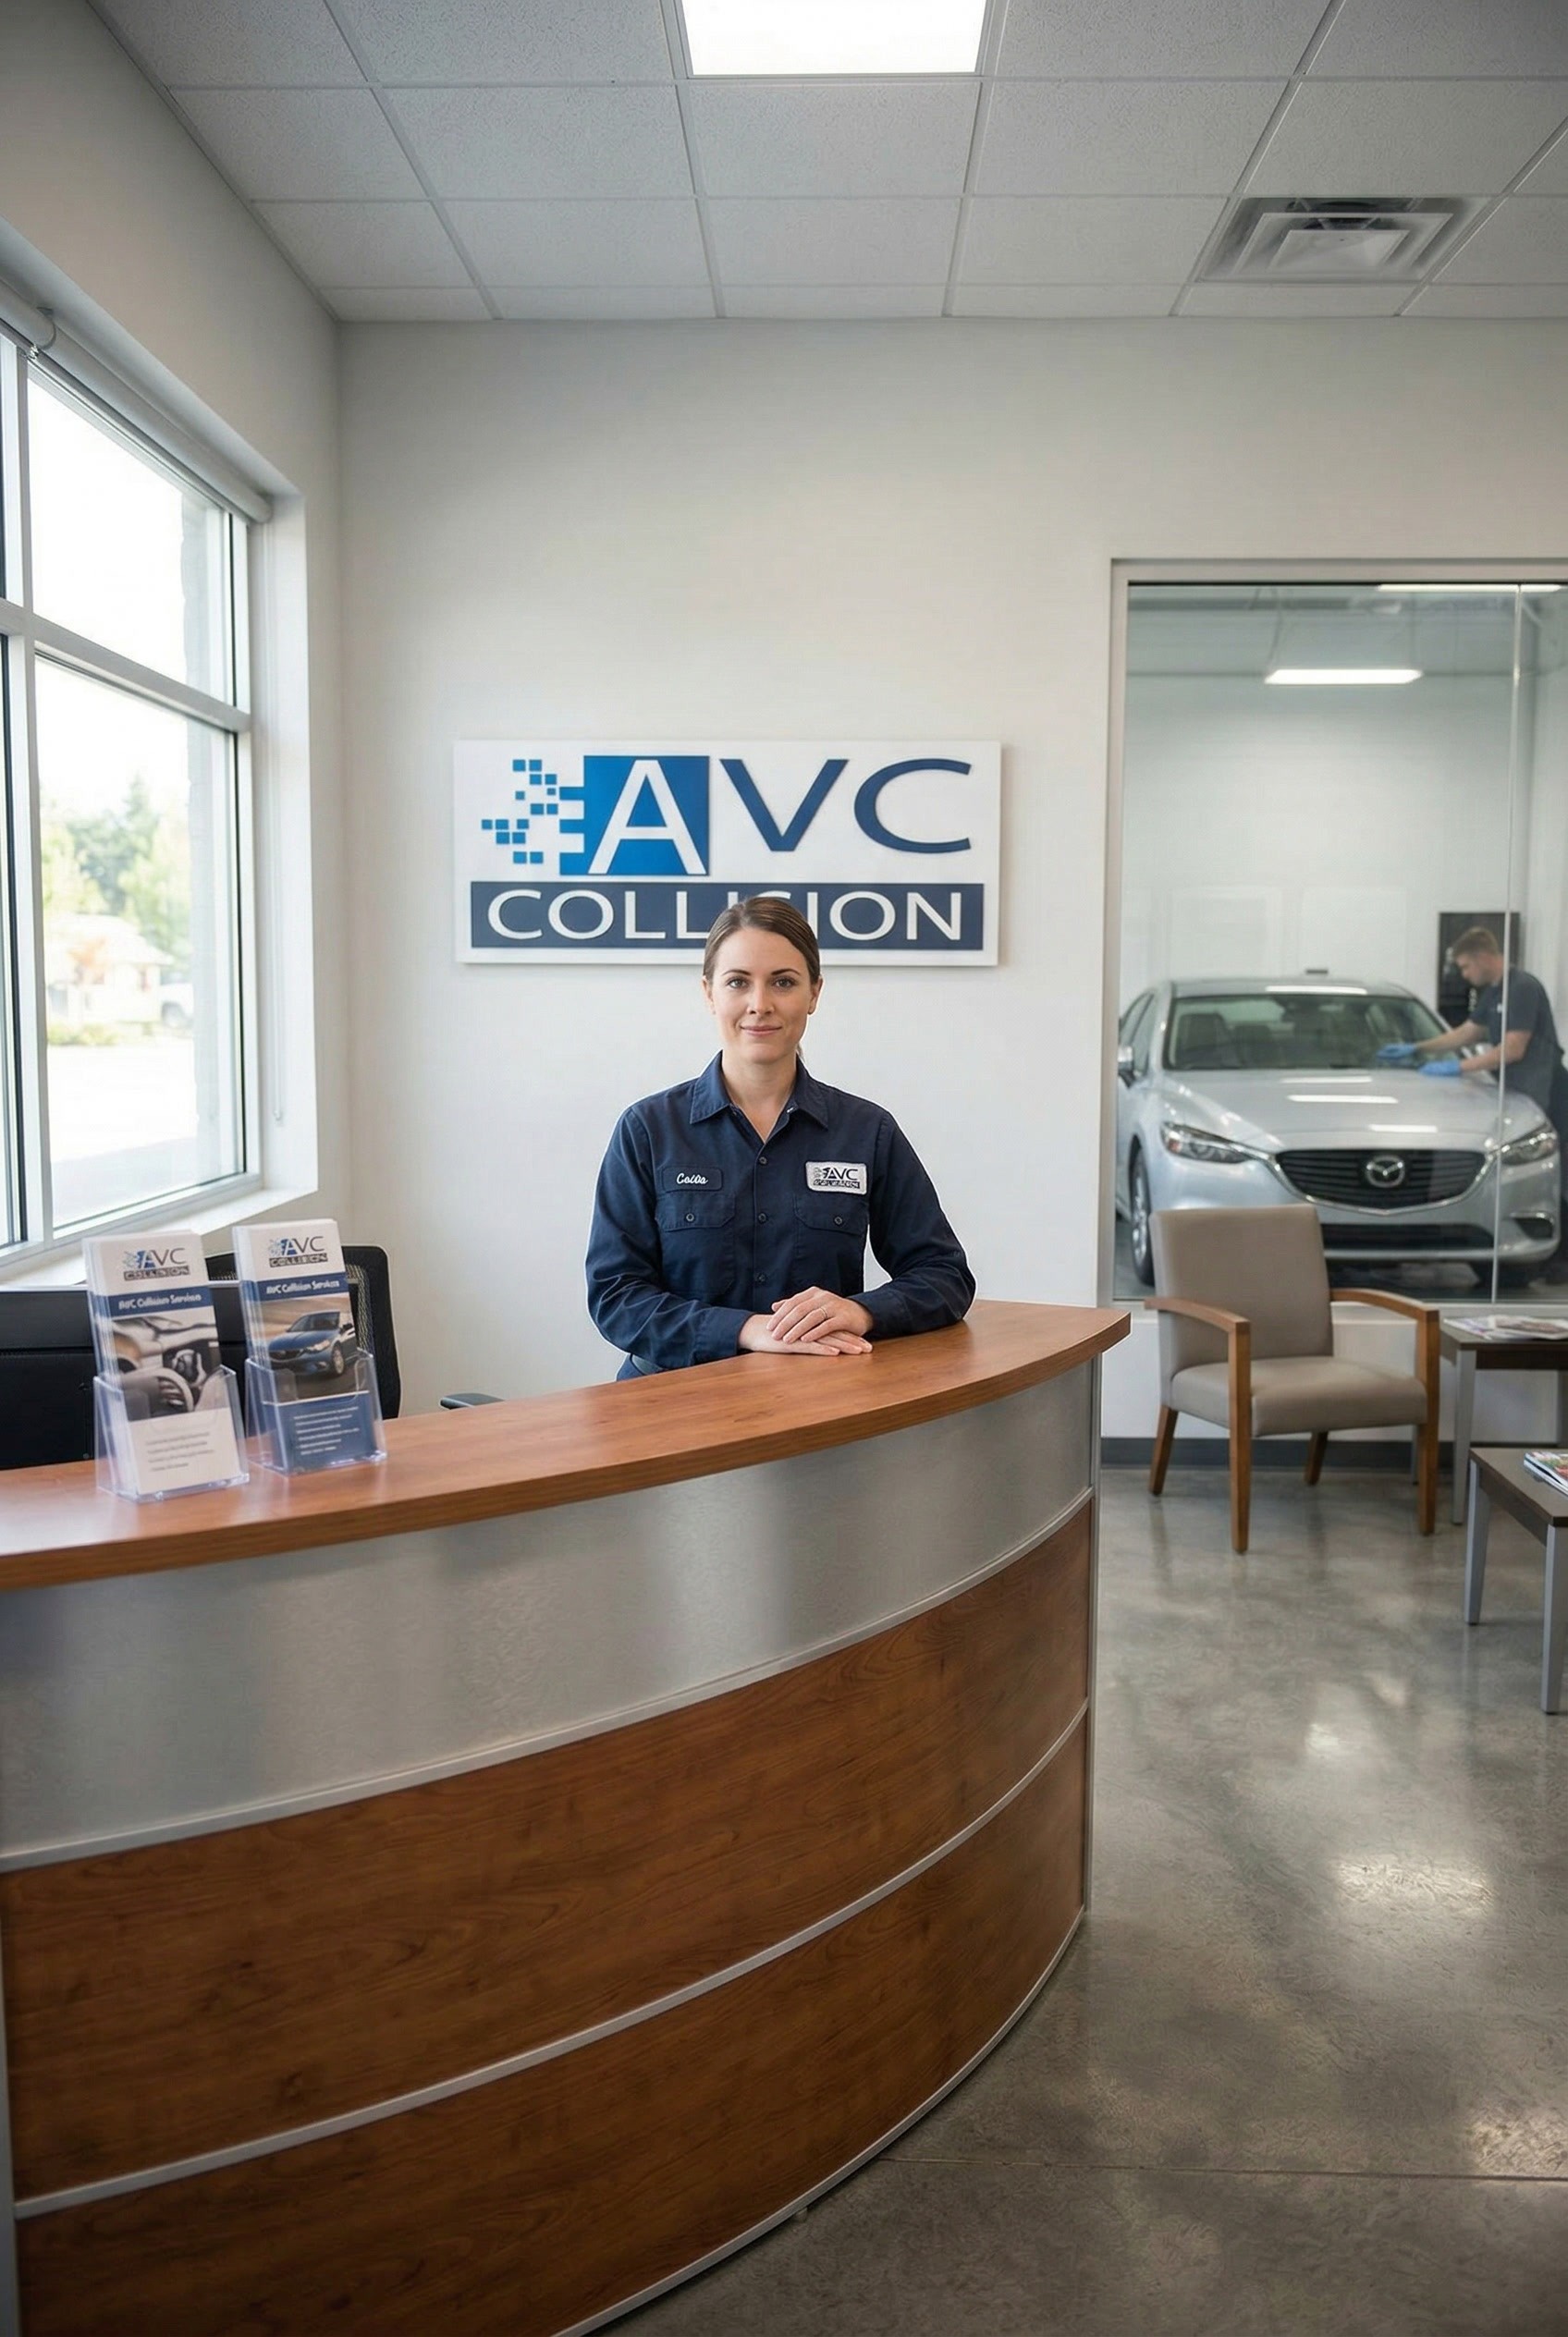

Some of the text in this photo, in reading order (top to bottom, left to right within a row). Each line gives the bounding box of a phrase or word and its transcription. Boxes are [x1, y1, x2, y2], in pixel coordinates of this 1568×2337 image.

[587, 759, 972, 875] AVC
[487, 889, 962, 941] COLLION
[827, 1167, 858, 1181] AVC
[281, 1236, 325, 1256] AVC
[139, 1247, 187, 1269] AVC
